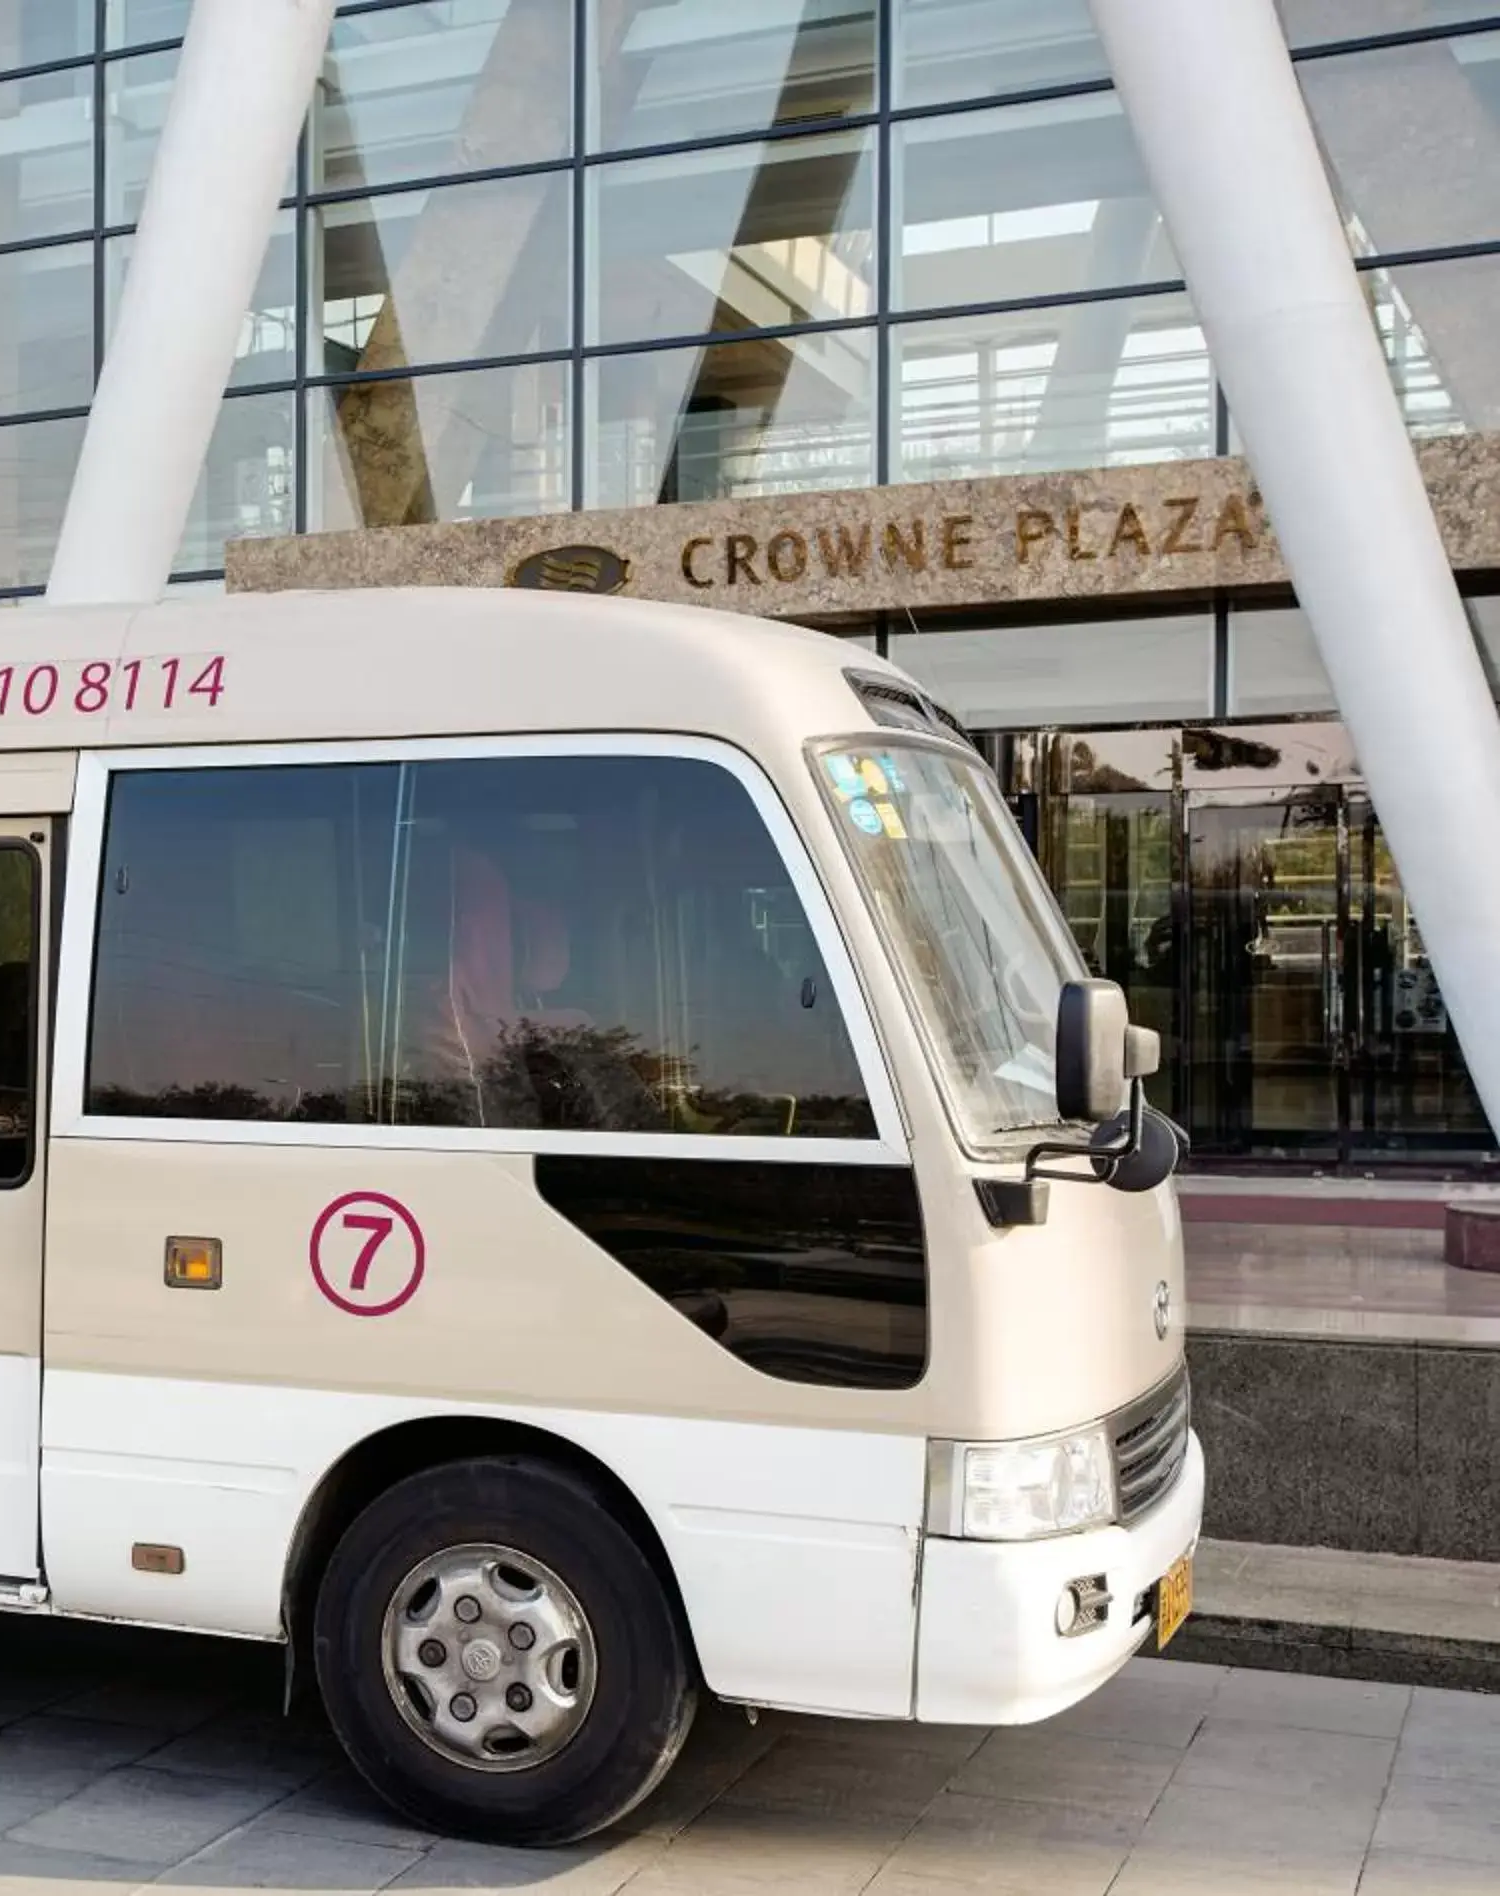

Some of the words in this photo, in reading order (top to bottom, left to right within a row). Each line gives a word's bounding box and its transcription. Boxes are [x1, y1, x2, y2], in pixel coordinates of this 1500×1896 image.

[681, 513, 973, 588] CROWNE
[1015, 493, 1258, 565] PLAZA
[75, 656, 227, 713] 8114
[342, 1213, 394, 1291] 7
